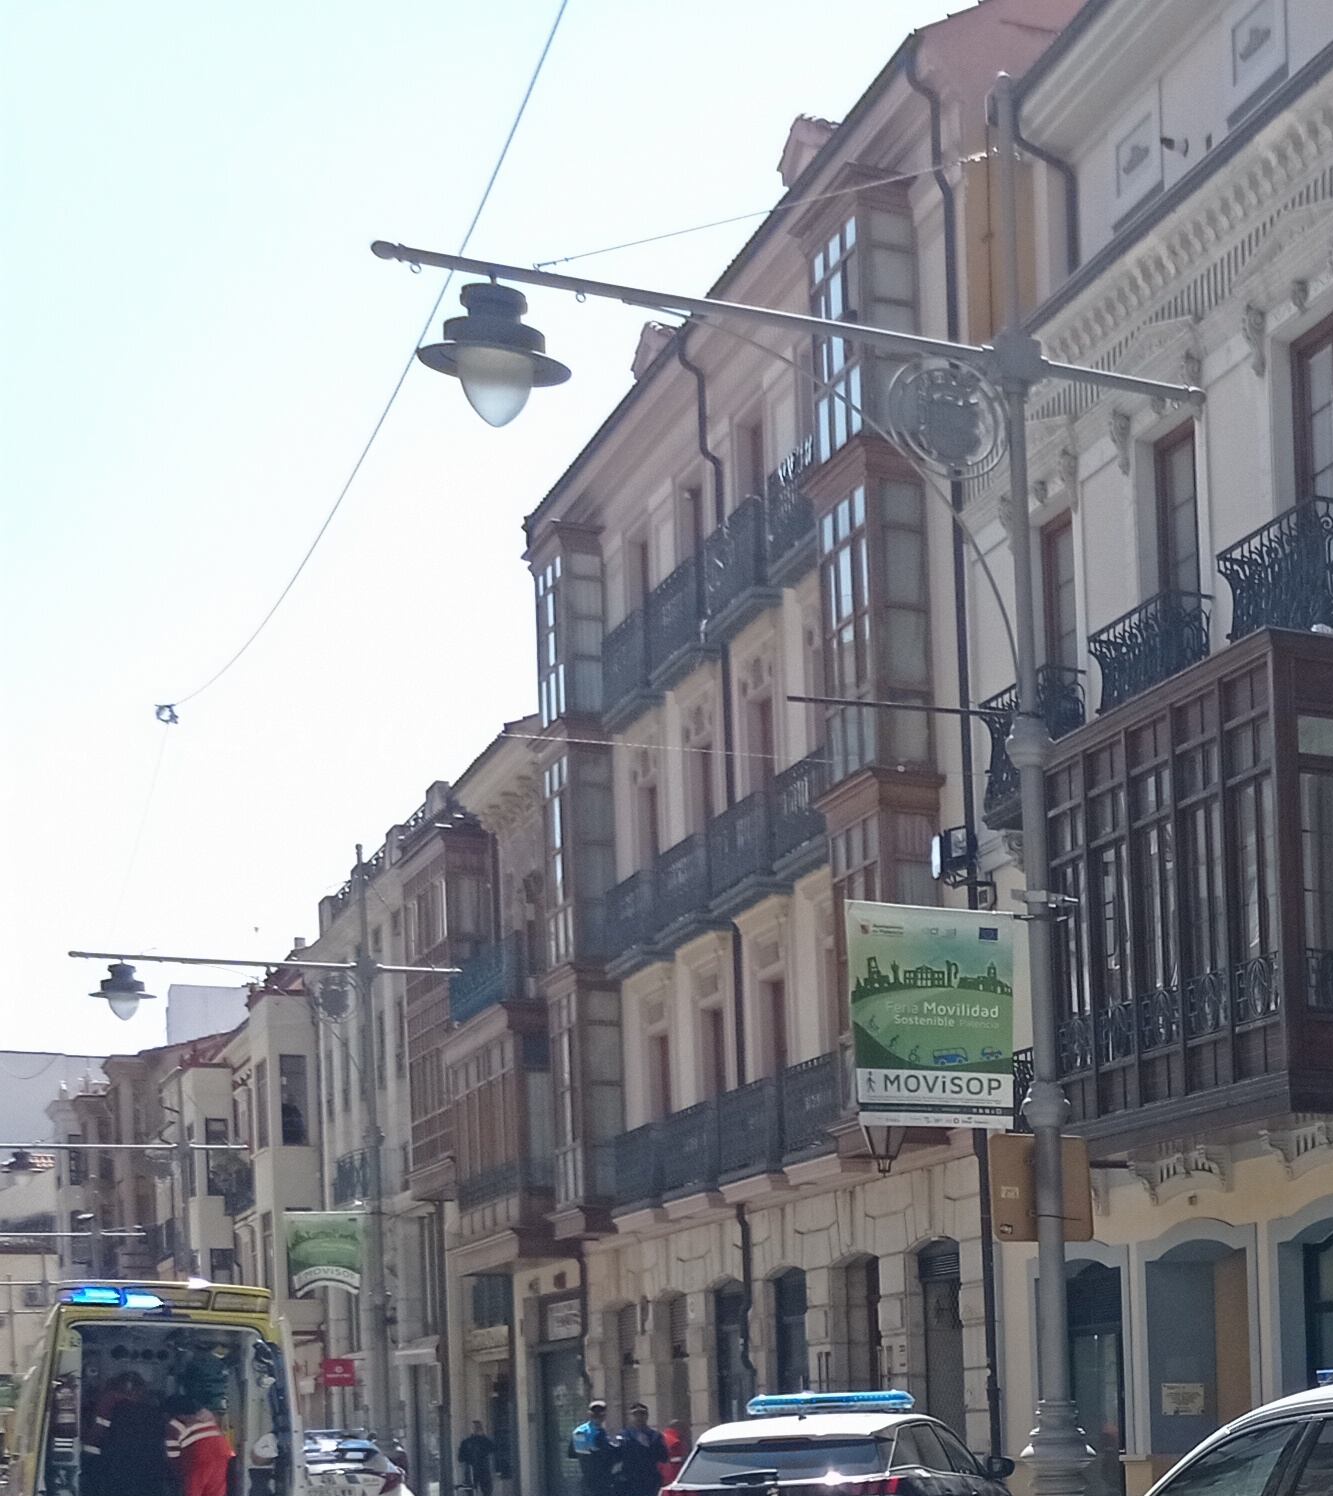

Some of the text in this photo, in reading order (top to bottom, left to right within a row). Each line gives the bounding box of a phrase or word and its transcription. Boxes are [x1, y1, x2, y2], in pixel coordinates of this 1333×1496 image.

[886, 1002, 999, 1018] Feria Movilidad
[895, 1015, 955, 1027] Sostenible
